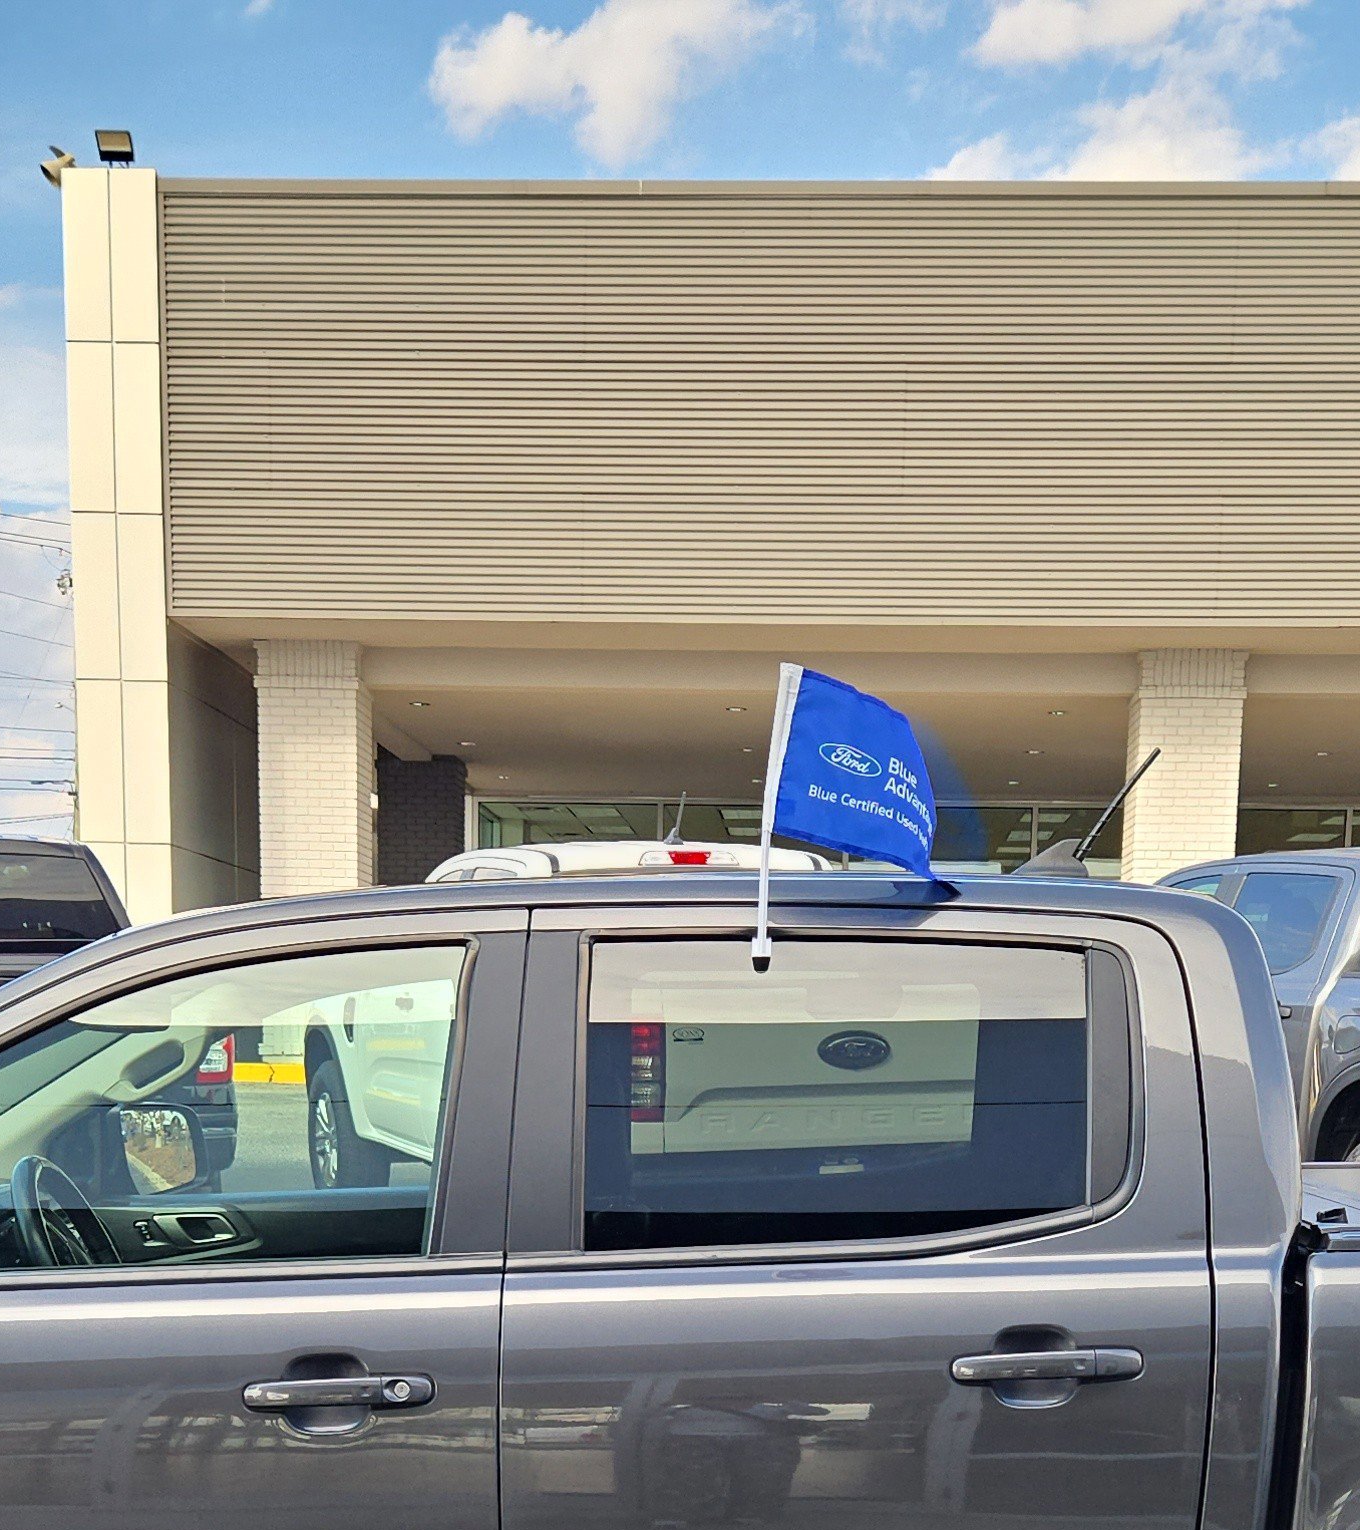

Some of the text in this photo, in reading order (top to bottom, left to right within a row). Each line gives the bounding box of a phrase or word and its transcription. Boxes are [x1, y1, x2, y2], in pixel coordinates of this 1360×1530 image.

[831, 747, 871, 773] Ford
[888, 757, 918, 789] Blue
[808, 784, 919, 836] Blue Certified Used
[700, 1106, 971, 1133] RANGE
